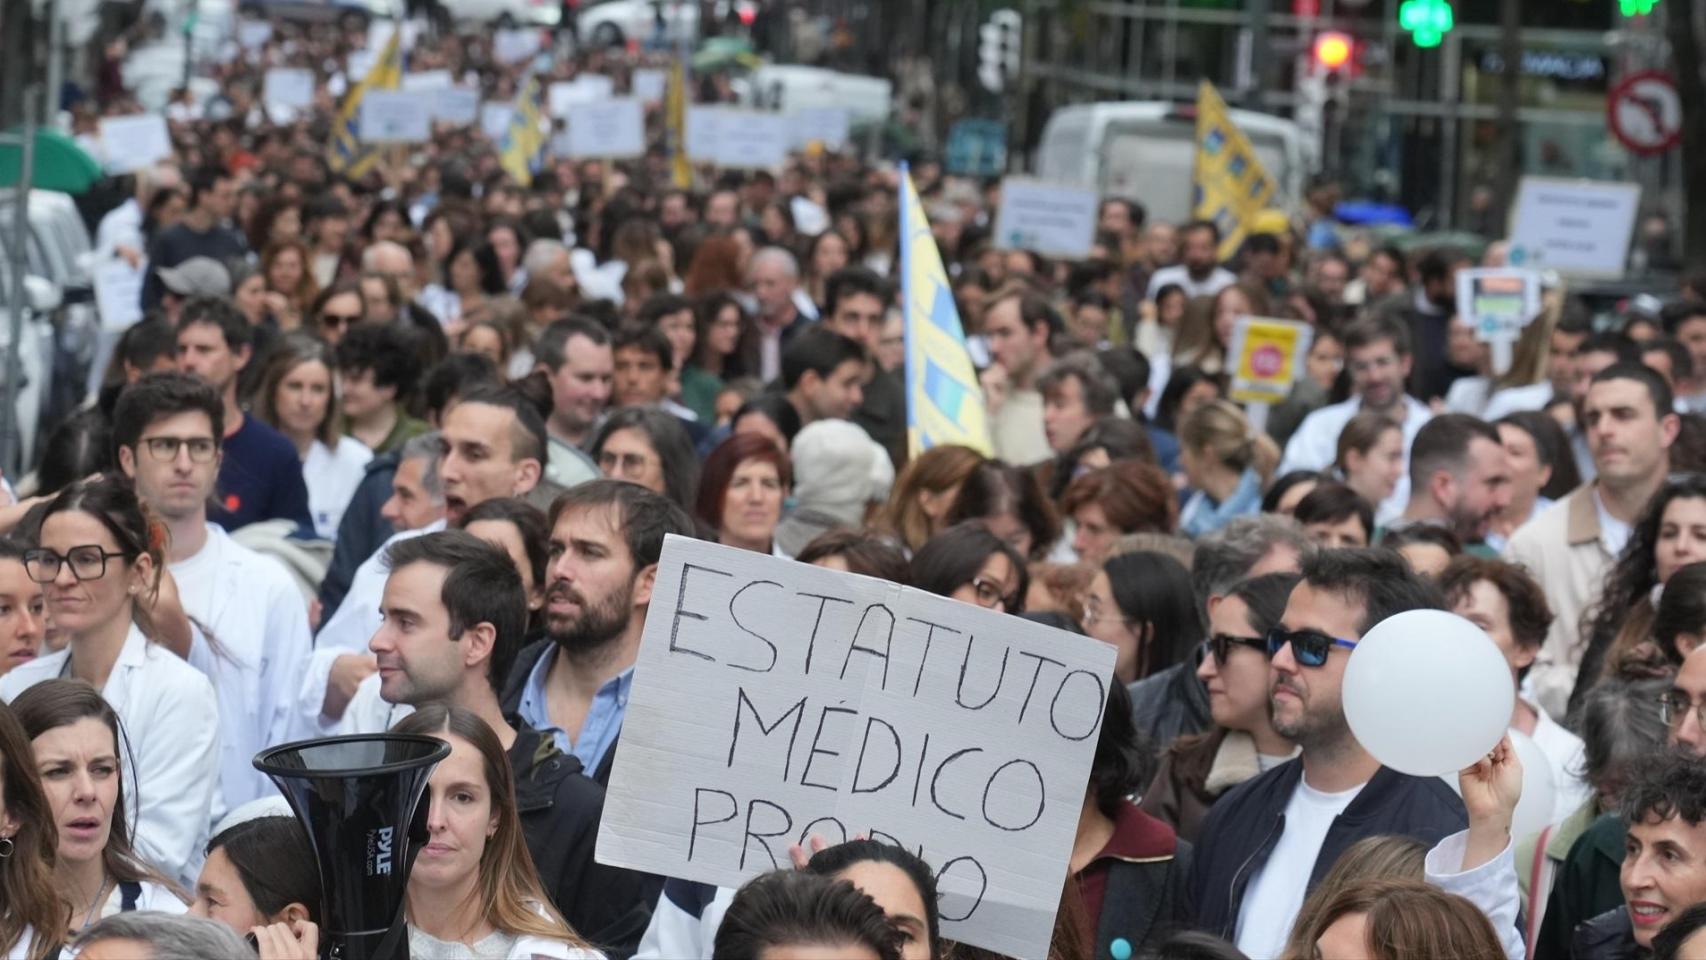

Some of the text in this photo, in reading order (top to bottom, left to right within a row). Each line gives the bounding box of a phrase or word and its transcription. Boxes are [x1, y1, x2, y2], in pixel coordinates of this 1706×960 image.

[669, 562, 1105, 742] ESTATUTO
[727, 686, 1045, 832] MÉDICO
[377, 827, 394, 875] PYLE
[688, 788, 987, 921] PRO
